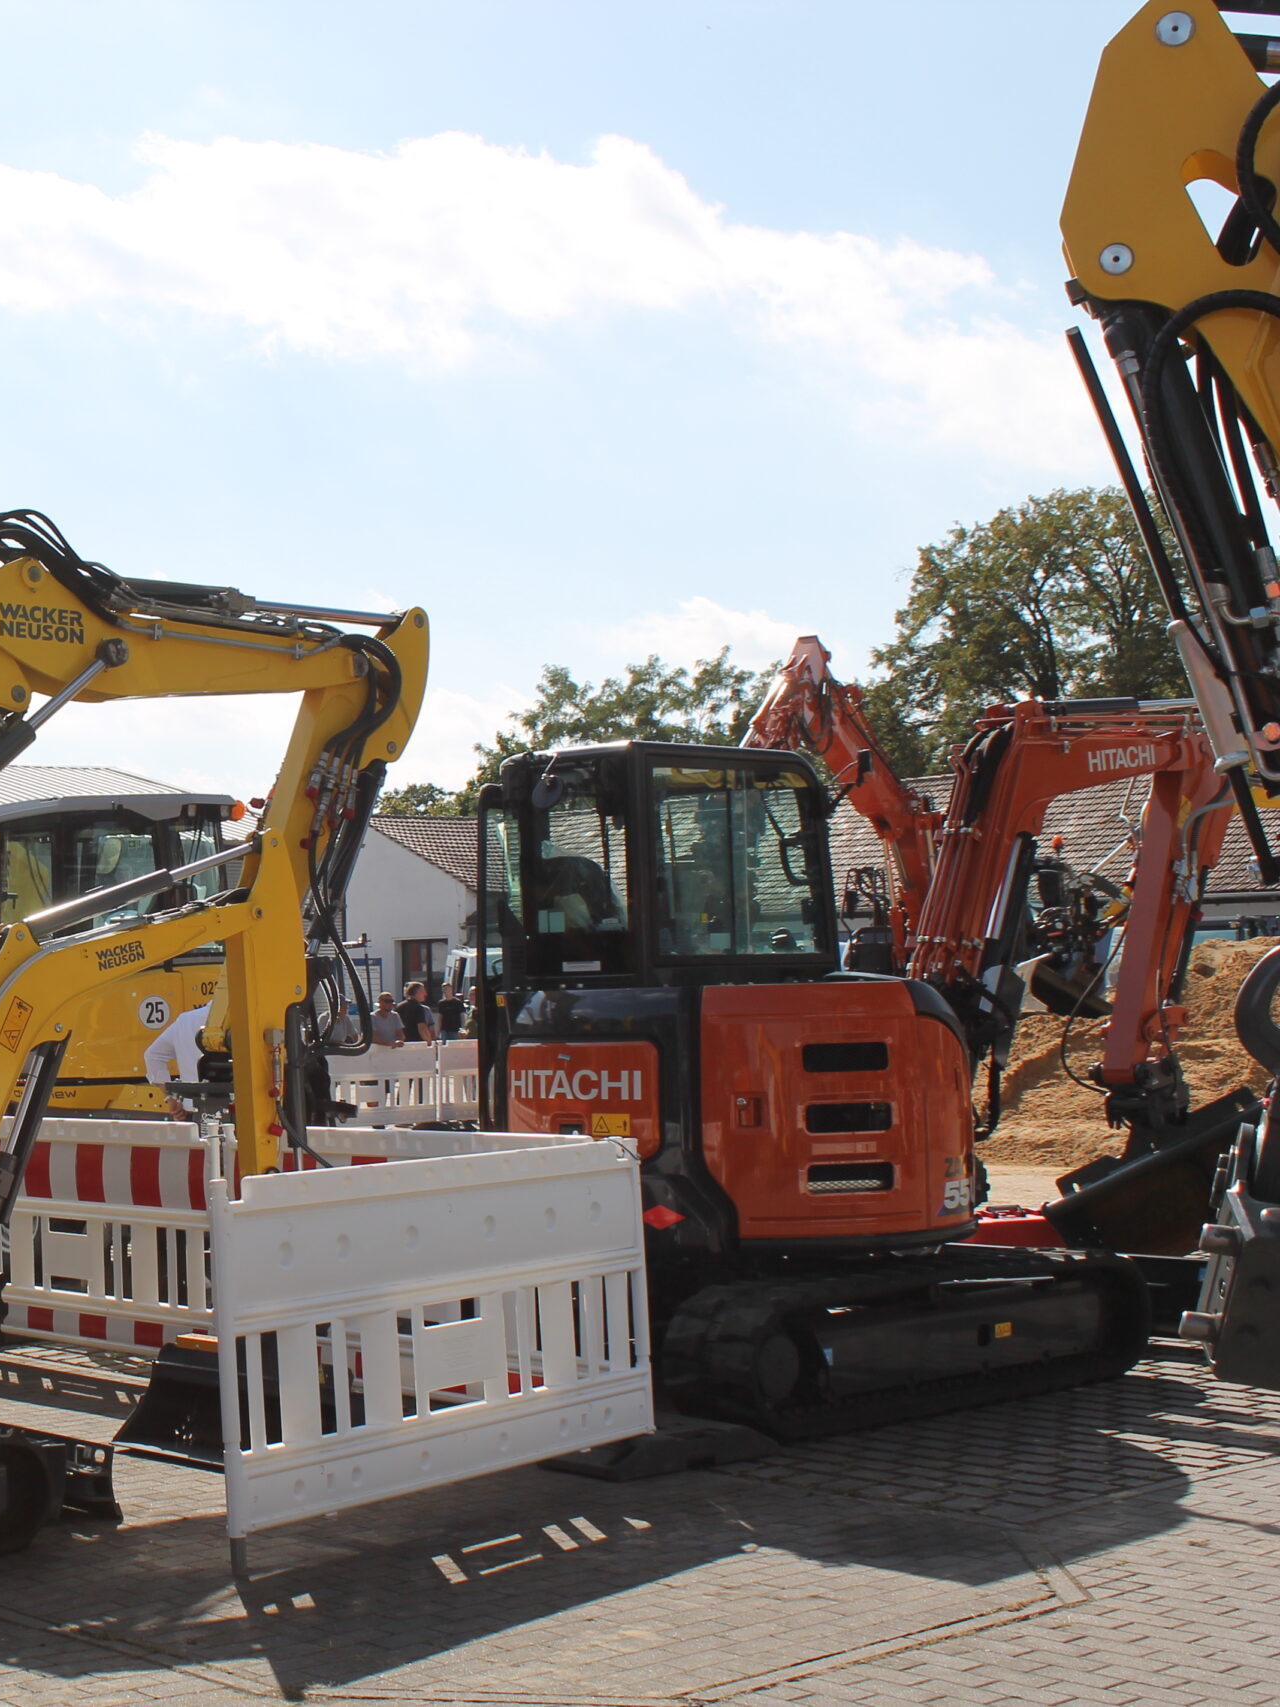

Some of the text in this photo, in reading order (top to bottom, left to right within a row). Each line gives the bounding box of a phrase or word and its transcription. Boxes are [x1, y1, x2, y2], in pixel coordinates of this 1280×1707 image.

[0, 620, 84, 645] NEUSON
[1088, 744, 1156, 772] HITACHI
[95, 940, 143, 960] WACKER
[98, 950, 145, 971] NEUSON
[145, 1002, 165, 1024] 25
[511, 1069, 642, 1100] HITACHI
